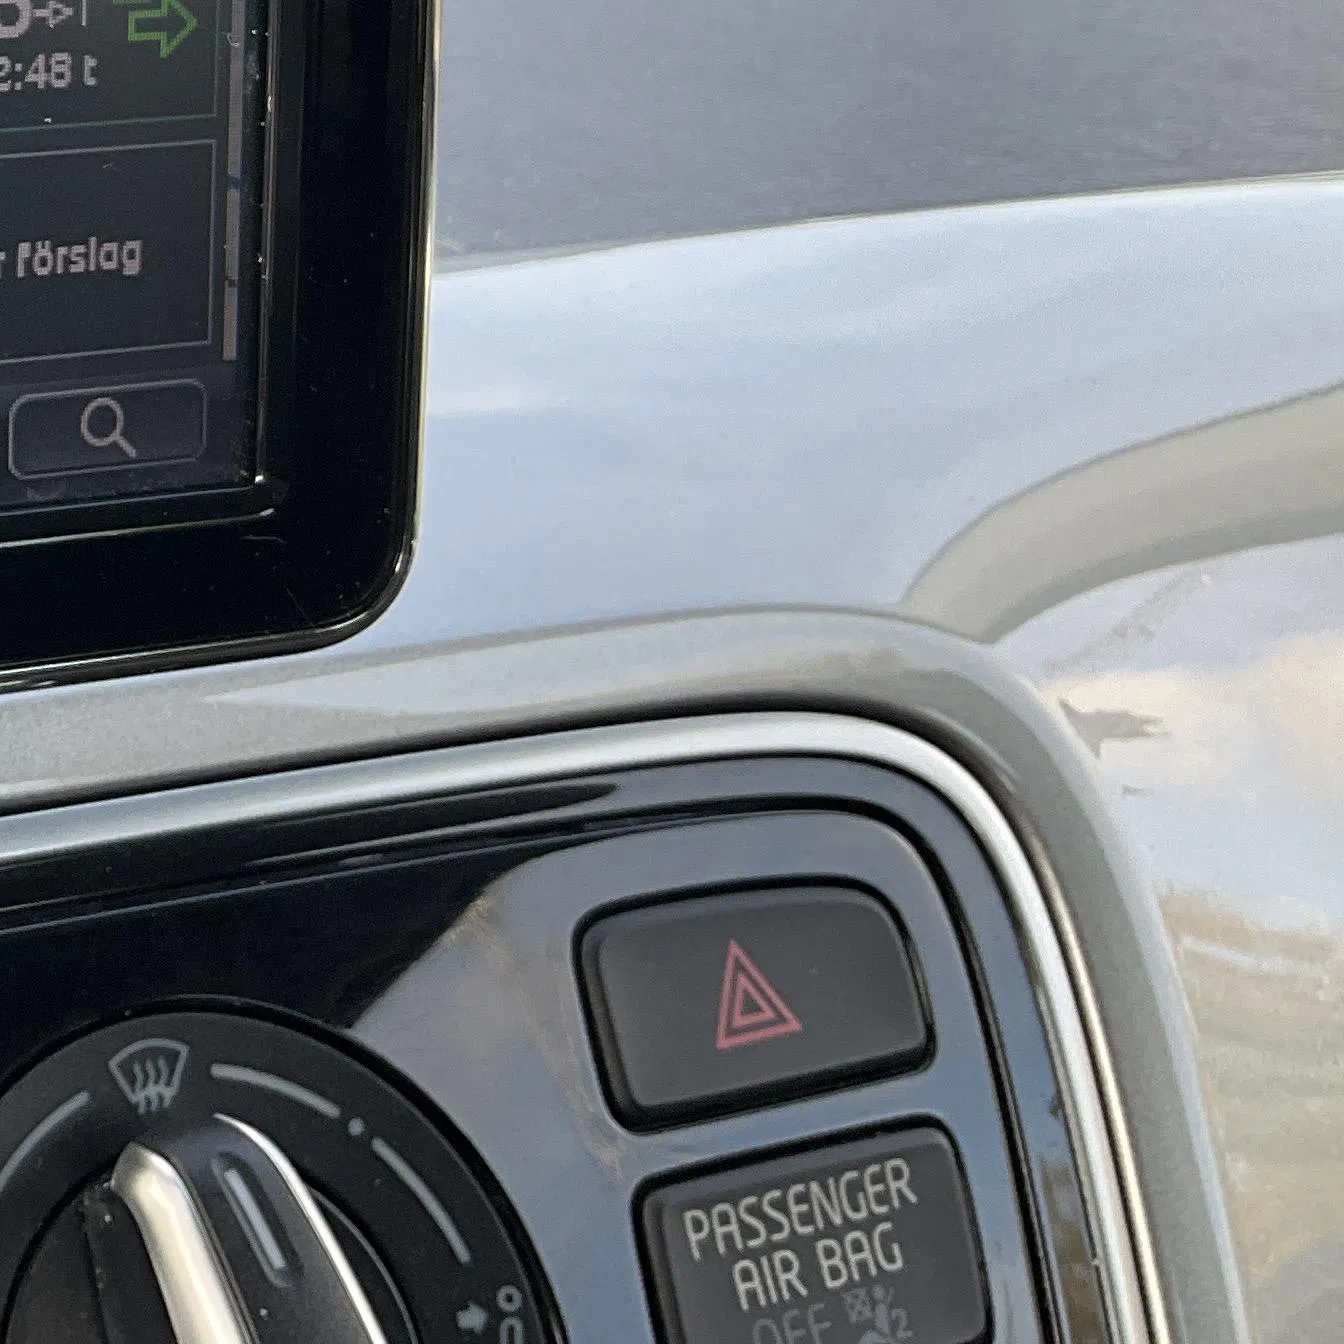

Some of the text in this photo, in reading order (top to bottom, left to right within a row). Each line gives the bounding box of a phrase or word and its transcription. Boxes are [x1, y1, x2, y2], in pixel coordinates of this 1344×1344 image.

[85, 57, 99, 88] t
[16, 236, 143, 277] förslag
[682, 1157, 919, 1261] PASSENGER
[732, 1221, 905, 1312] AIR BAG
[752, 1302, 832, 1344] OFF
